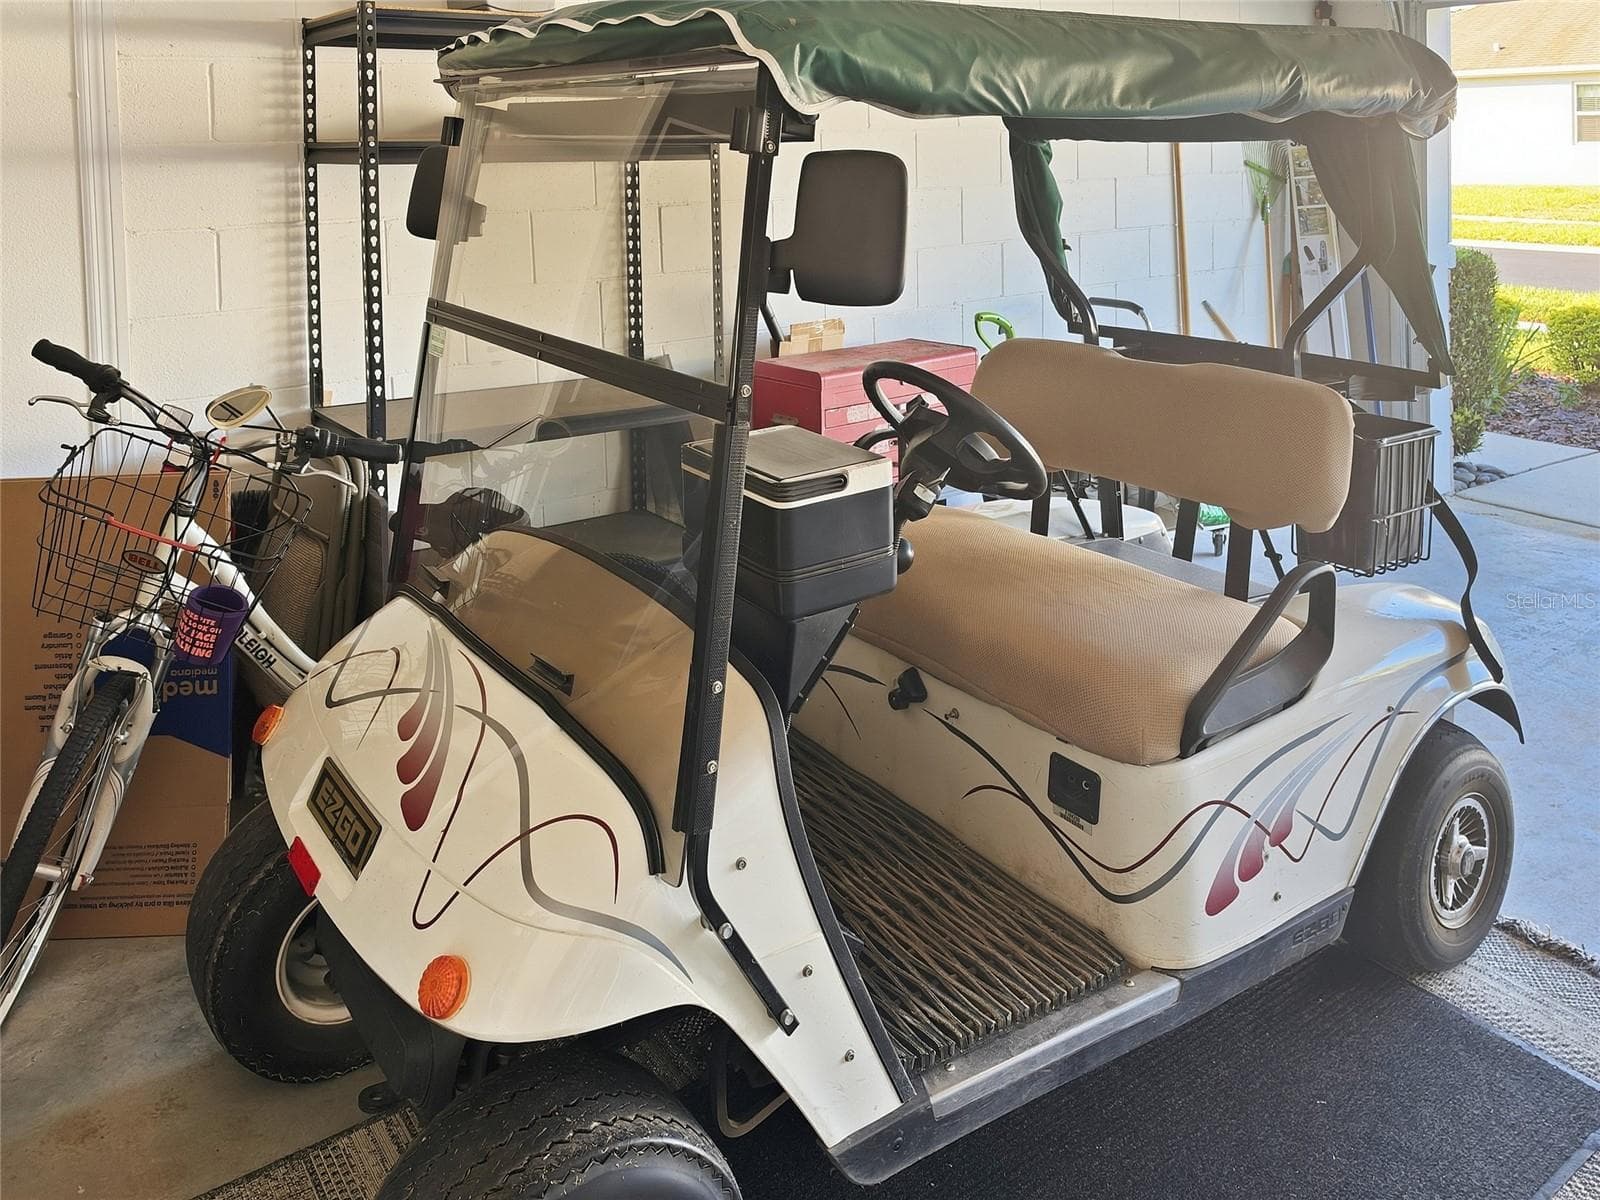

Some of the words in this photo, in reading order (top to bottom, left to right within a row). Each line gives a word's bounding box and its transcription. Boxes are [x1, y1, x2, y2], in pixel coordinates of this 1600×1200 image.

[128, 552, 161, 571] BELL
[188, 619, 209, 632] LOOK
[43, 632, 73, 640] Garage
[176, 636, 213, 658] ALKING
[194, 640, 214, 649] STILL
[238, 631, 278, 669] LEIGH
[170, 667, 218, 678] mediana
[162, 679, 218, 703] med
[24, 694, 47, 702] Room
[315, 777, 367, 858] EZGO
[109, 901, 134, 909] picking
